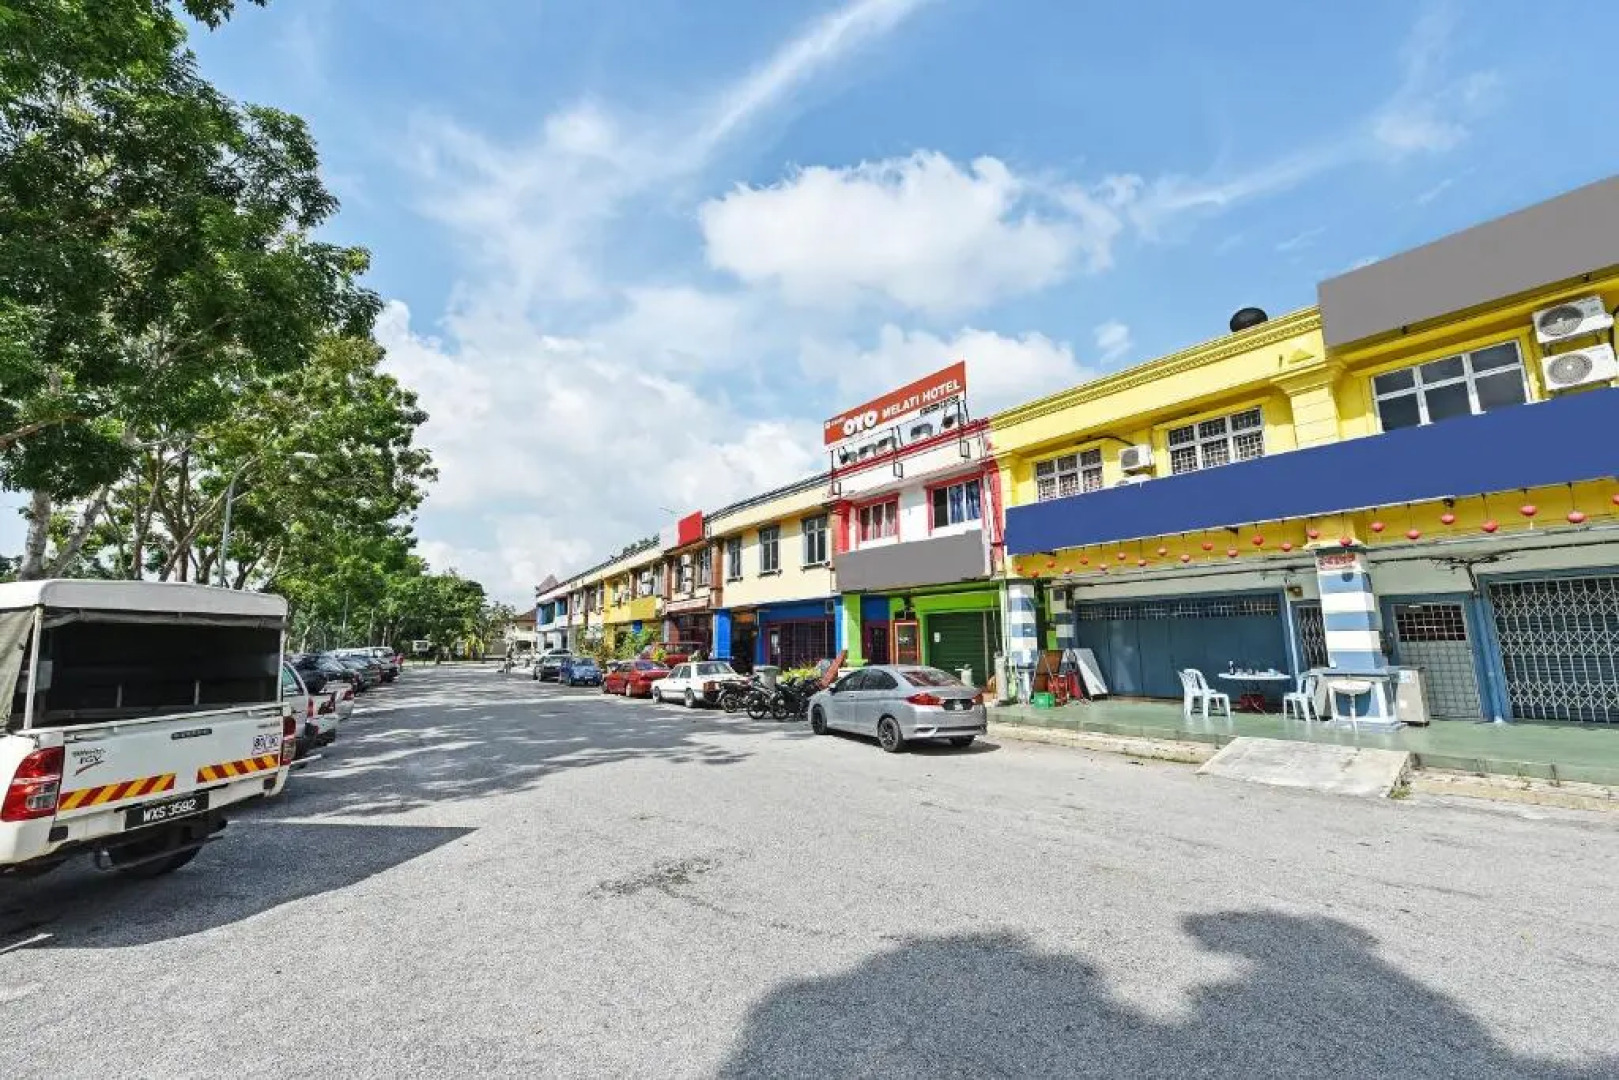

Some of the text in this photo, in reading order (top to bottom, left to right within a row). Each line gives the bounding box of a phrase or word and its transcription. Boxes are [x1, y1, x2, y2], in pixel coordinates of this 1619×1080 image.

[843, 410, 878, 436] OYO
[882, 394, 920, 418] MELATI
[922, 379, 960, 402] HOTEL
[143, 798, 196, 822] WXS 3592
